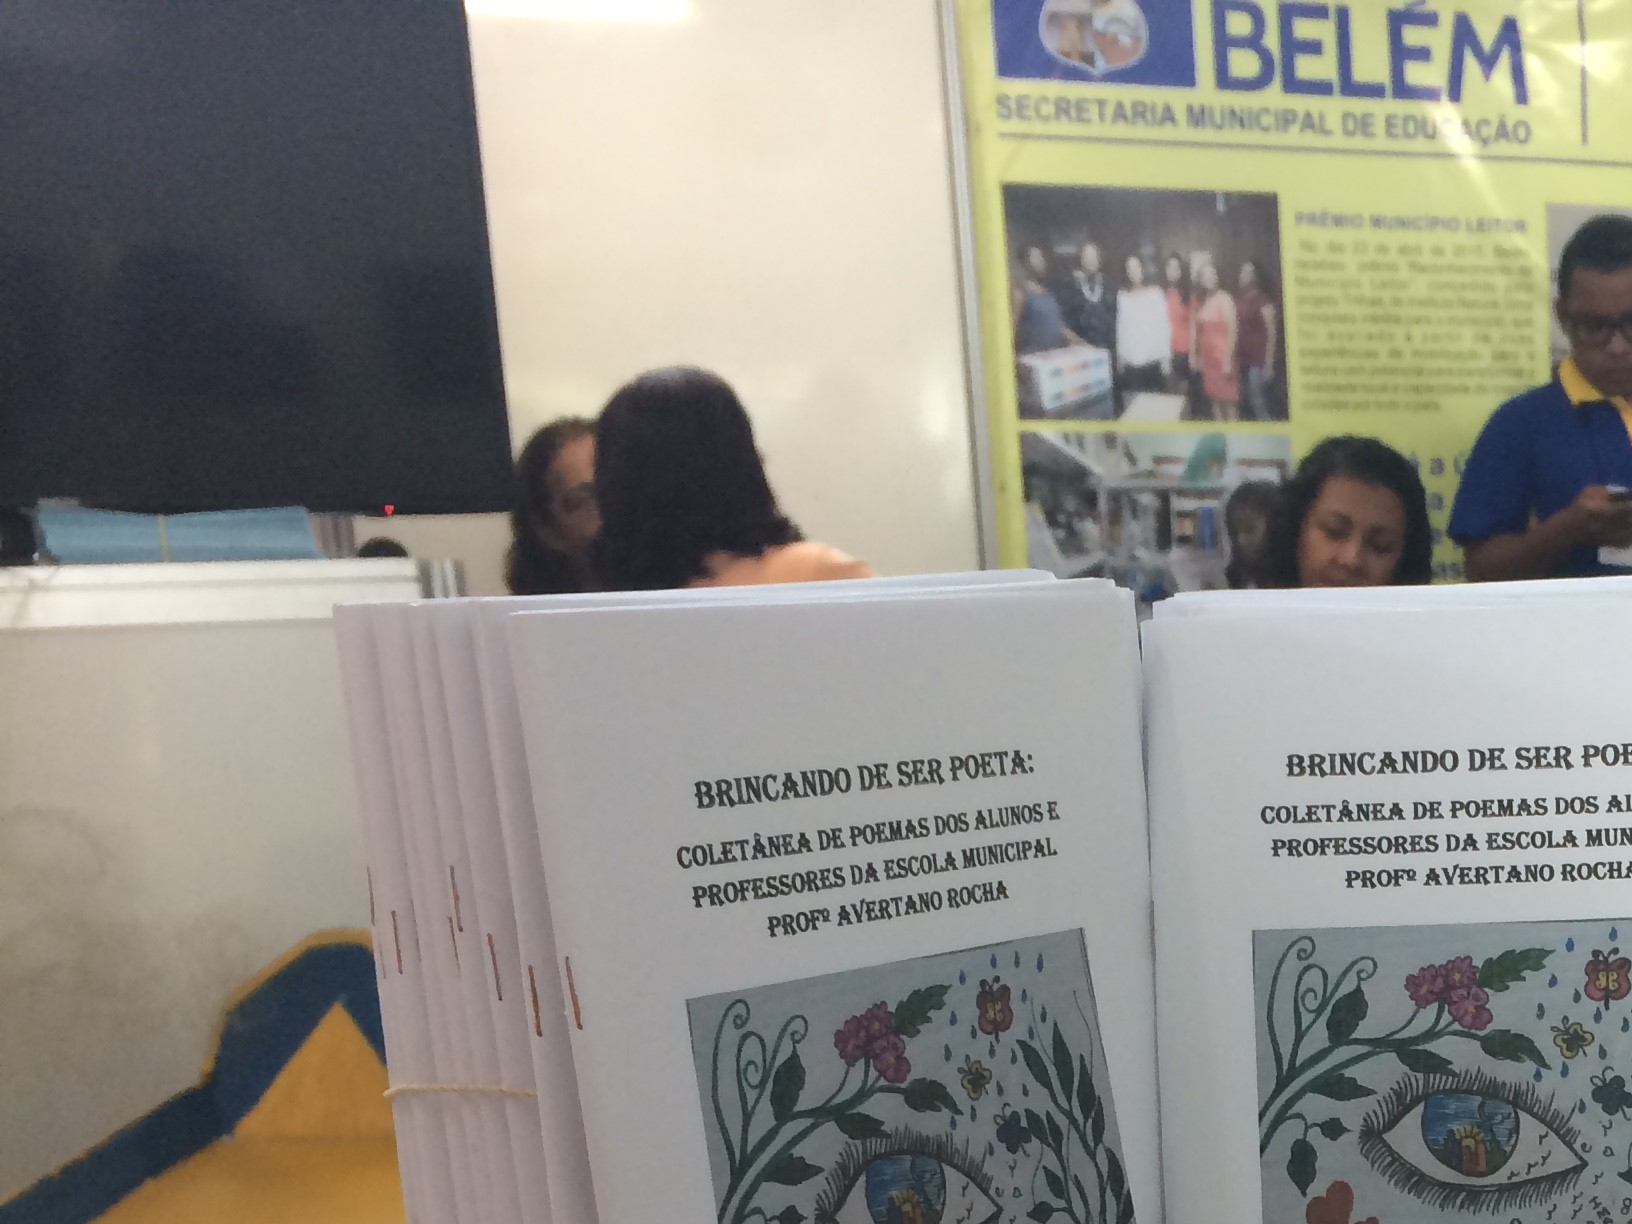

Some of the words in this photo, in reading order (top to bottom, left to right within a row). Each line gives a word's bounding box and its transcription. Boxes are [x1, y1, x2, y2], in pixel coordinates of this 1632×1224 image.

[995, 94, 1177, 127] SECRETARIA
[1186, 103, 1333, 137] MUNICIPAL
[1342, 112, 1375, 138] DE
[1384, 113, 1532, 146] EDUCAÇÃO
[694, 768, 851, 809] BRINCANDO
[857, 763, 893, 791] DE
[897, 758, 945, 787] SER
[949, 750, 1034, 781] POETA:
[1286, 750, 1459, 778] BRINCANDO
[1467, 748, 1508, 771] DE
[1515, 746, 1574, 770] SER
[1261, 800, 1406, 824] COLETÂNEA
[1413, 801, 1444, 820] DE
[1449, 798, 1548, 819] POEMAS
[1555, 796, 1599, 815] DOS
[677, 832, 813, 869] COLETÂNEA
[817, 827, 846, 851] DE
[849, 817, 930, 847] POEMAS
[934, 812, 969, 835] DOS
[974, 803, 1043, 830] ALUNOS
[1047, 801, 1060, 821] E
[1271, 835, 1439, 858] PROFESSORES
[1446, 833, 1480, 852] DA
[1486, 830, 1579, 850] ESCOLA
[692, 867, 846, 908] PROFESSORES
[850, 862, 880, 885] DA
[883, 852, 959, 880] ESCOLA
[961, 837, 1058, 869] MUNICIPAL
[1423, 864, 1554, 886] AVERTANO
[837, 891, 942, 927] AVERTANO
[947, 880, 1009, 909] ROCHA
